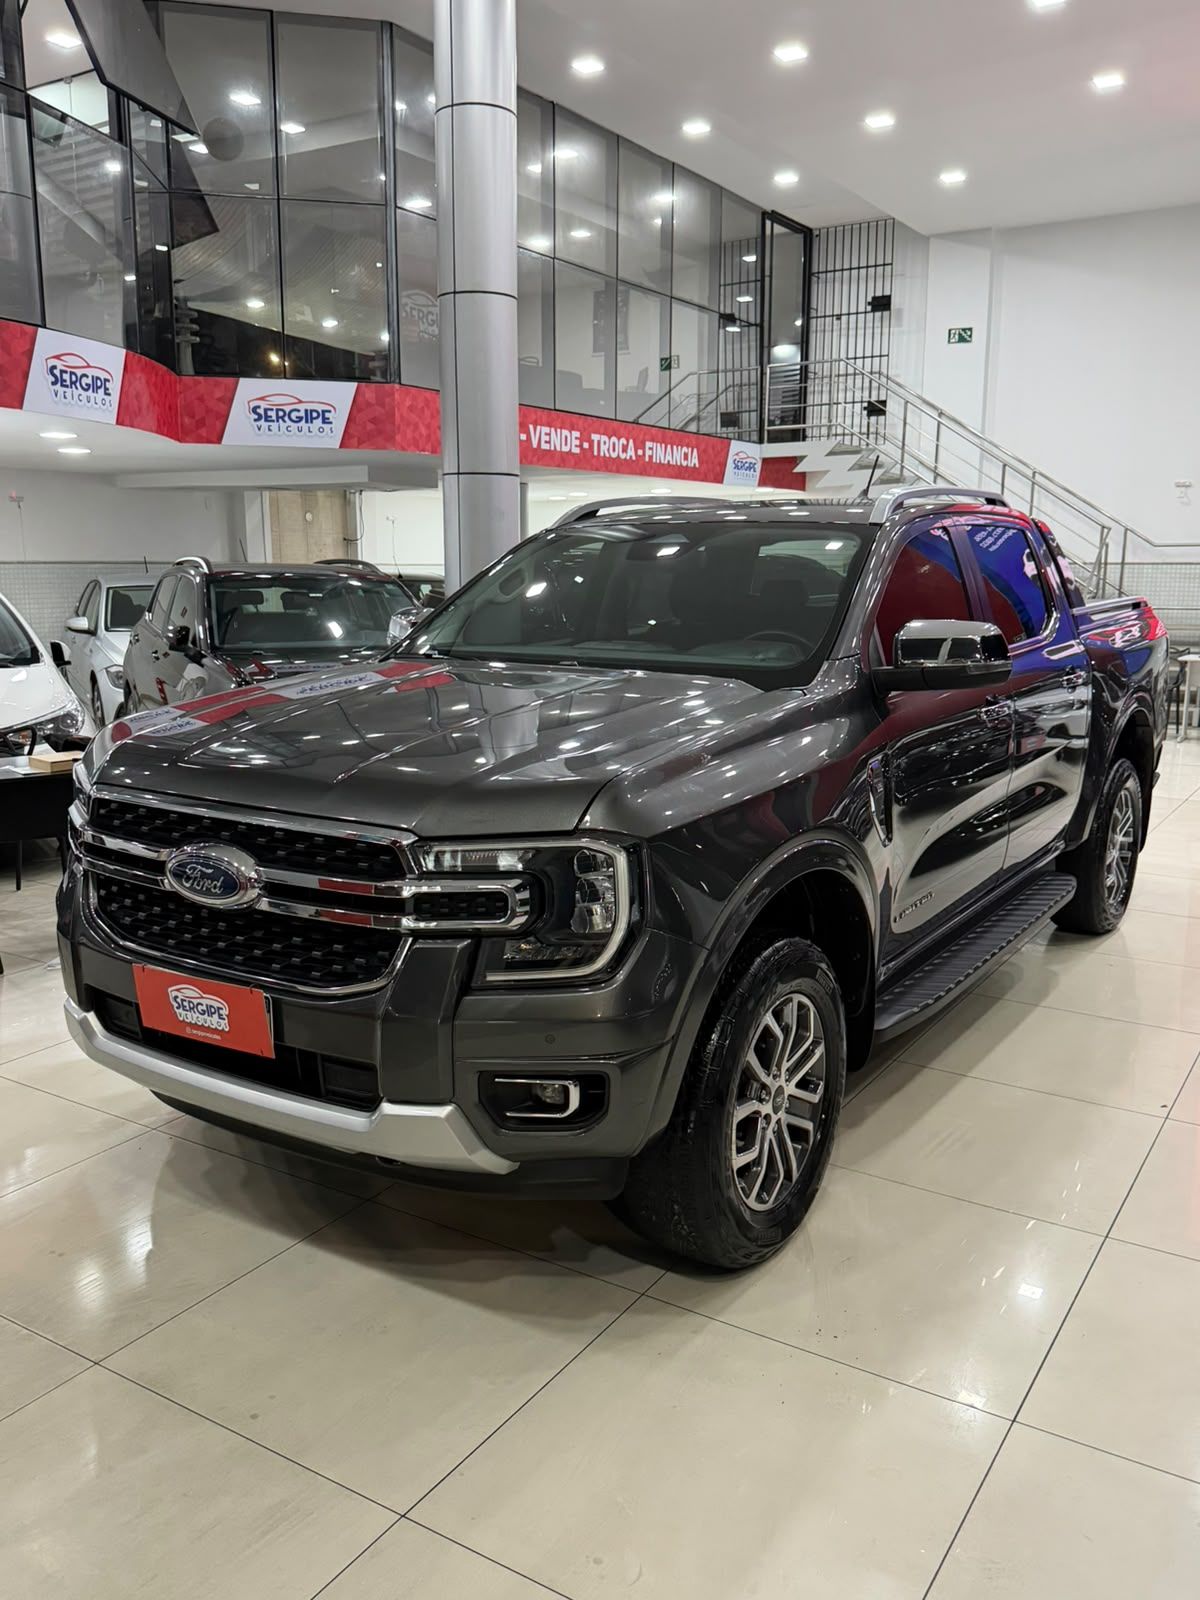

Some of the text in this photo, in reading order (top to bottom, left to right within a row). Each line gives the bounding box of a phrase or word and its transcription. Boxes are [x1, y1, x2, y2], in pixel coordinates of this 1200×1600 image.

[401, 303, 438, 328] SERGI
[49, 365, 111, 396] SERGIPE
[53, 389, 112, 407] VEÍCULOS
[252, 405, 333, 425] SERGIPE
[256, 423, 333, 433] VEÍCULOS
[529, 424, 580, 453] VENDE
[591, 433, 636, 460] TROCA
[645, 441, 699, 468] FINANCIA
[182, 864, 224, 893] Ford
[173, 995, 226, 1021] SERGIPE
